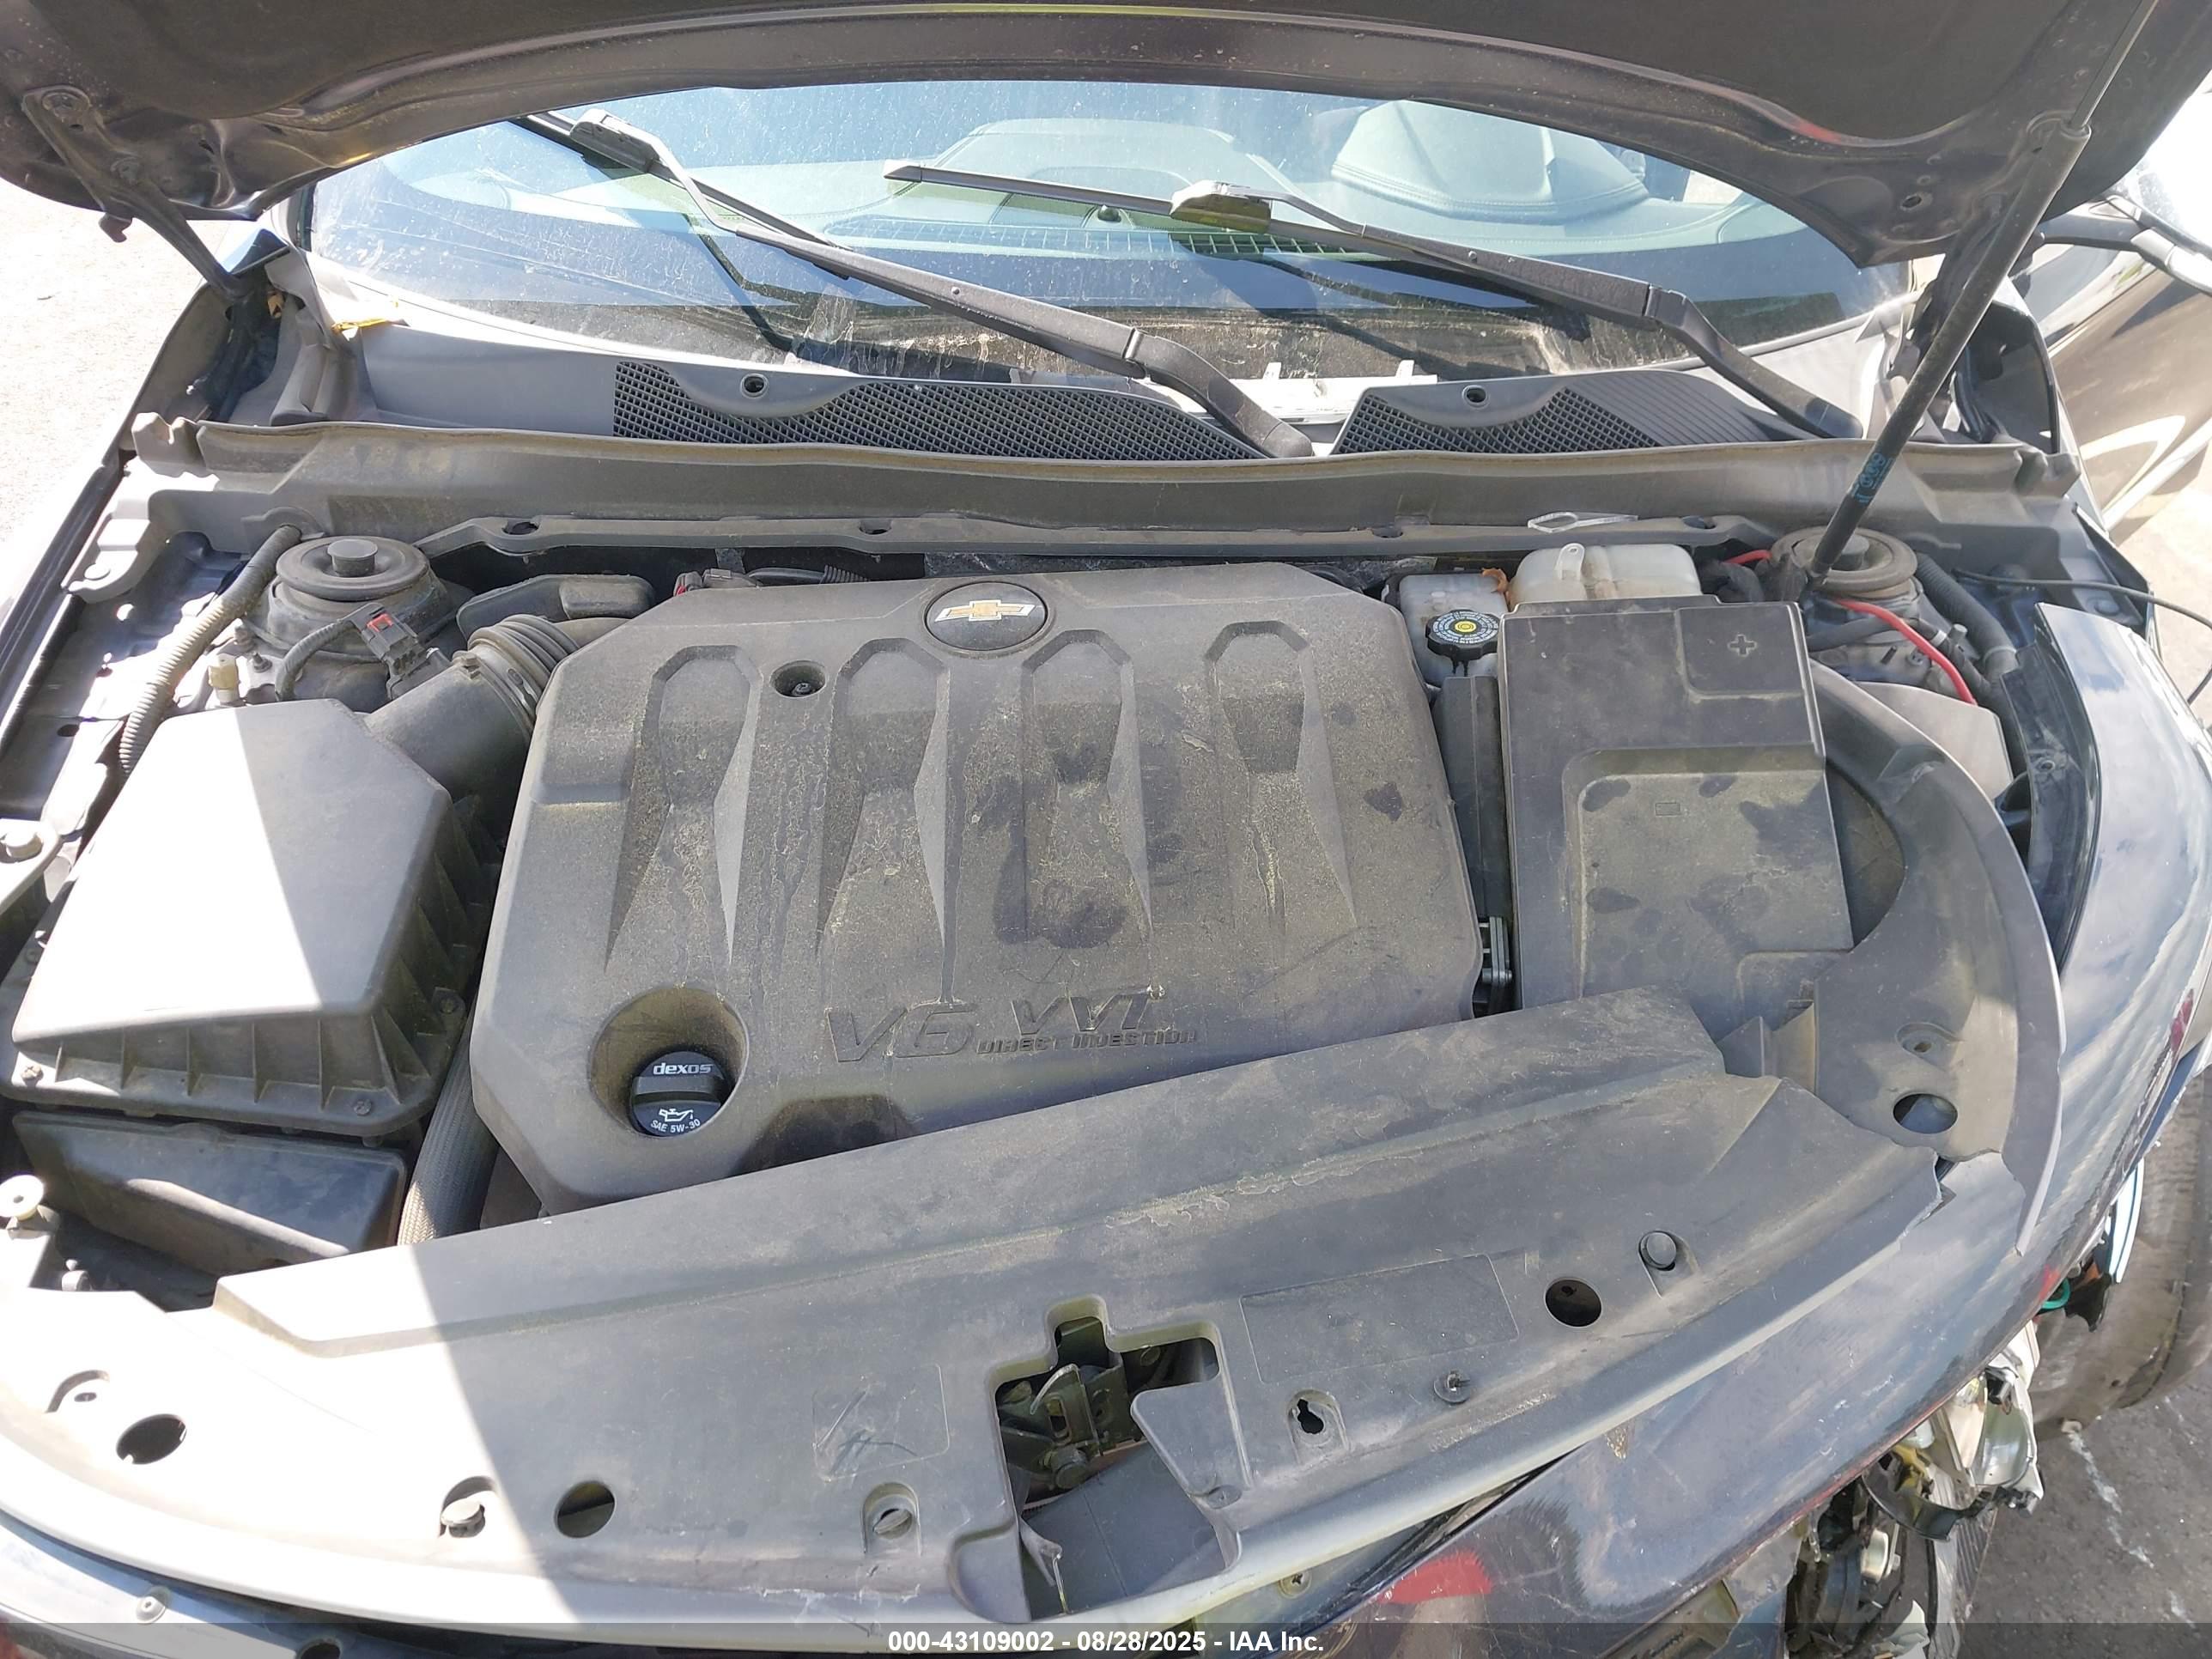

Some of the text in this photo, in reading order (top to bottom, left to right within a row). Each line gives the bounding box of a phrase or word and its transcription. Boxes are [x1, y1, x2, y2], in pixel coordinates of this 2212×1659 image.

[827, 991, 1161, 1062] V6 VVT
[976, 1030, 1197, 1054] DIRECT INJECTION
[653, 1062, 714, 1075] dexos
[650, 1119, 701, 1133] SAE 5W-30
